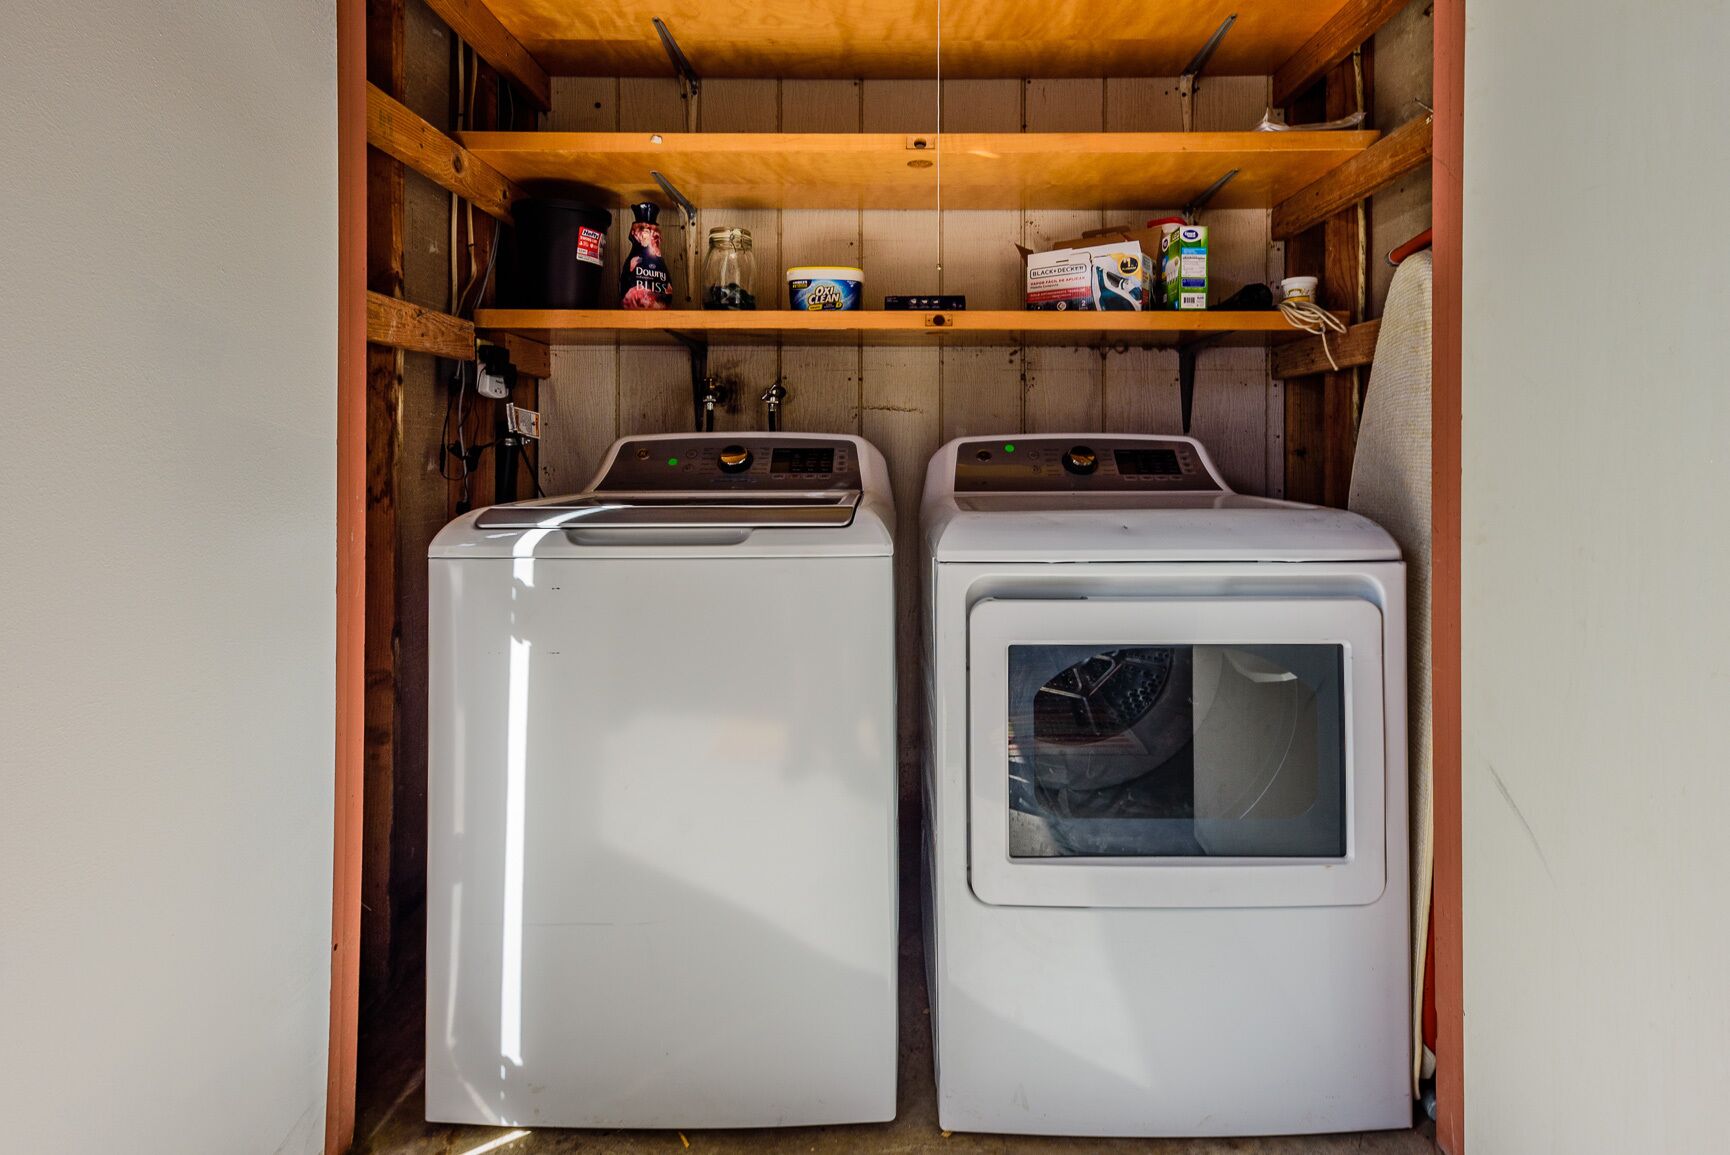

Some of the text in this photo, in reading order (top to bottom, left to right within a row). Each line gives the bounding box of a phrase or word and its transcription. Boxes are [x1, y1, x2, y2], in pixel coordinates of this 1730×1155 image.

[636, 266, 667, 281] Downy
[636, 280, 668, 293] BLISS
[815, 286, 834, 296] OXI
[808, 293, 839, 305] CLEAN
